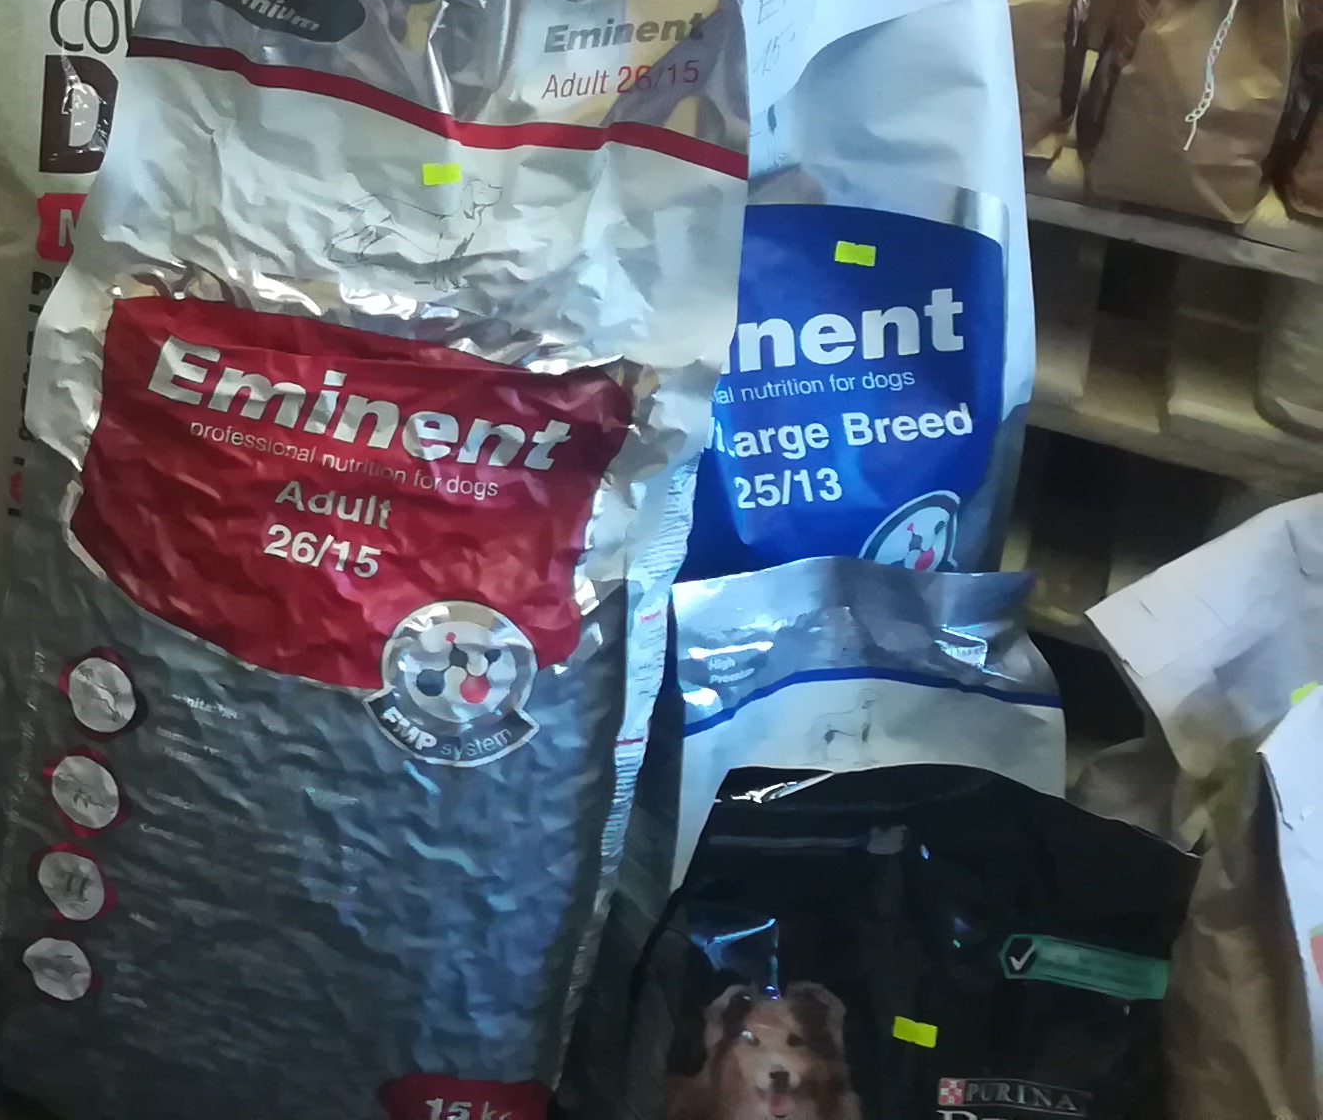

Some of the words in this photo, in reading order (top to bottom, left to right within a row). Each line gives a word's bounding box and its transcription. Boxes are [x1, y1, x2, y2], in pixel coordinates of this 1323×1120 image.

[543, 11, 708, 54] Eminent
[542, 70, 608, 101] Adult
[617, 61, 699, 96] 26/15
[147, 336, 574, 474] Eminent
[741, 379, 825, 403] nutrition
[829, 373, 856, 393] for
[862, 369, 916, 393] dogs
[842, 402, 974, 447] Breed
[189, 419, 317, 465] professional
[321, 451, 409, 487] nutrition
[414, 466, 443, 491] for
[445, 475, 499, 501] dogs
[275, 480, 392, 531] Adult
[735, 467, 843, 510] 25/13
[264, 524, 382, 580] 26/15
[382, 707, 438, 753] FMP
[440, 725, 513, 762] system
[966, 1082, 1077, 1112] PURINA
